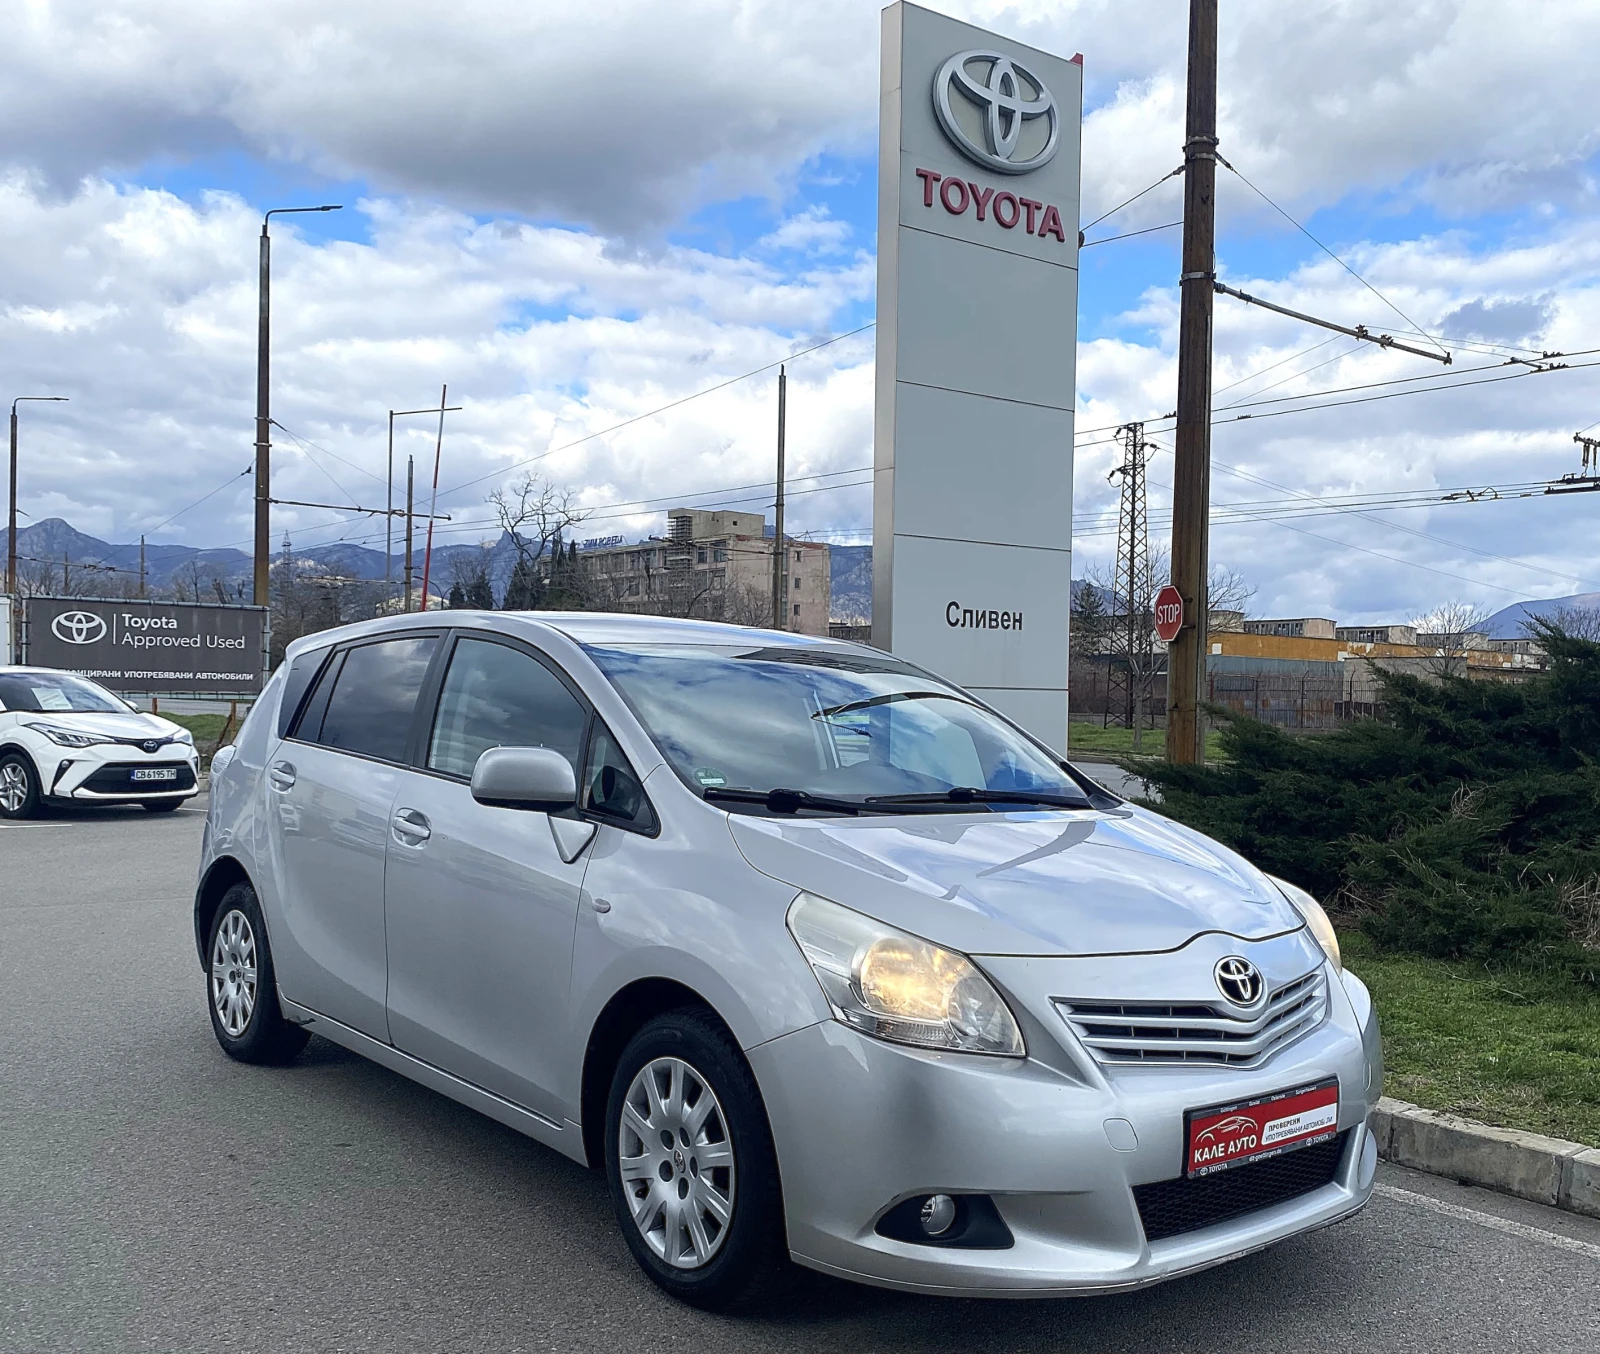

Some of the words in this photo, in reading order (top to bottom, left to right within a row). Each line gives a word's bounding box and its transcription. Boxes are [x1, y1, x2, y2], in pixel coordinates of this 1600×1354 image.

[916, 167, 1066, 243] TOYOTA
[121, 613, 178, 631] Toyota
[945, 600, 1023, 631] Сливен
[1157, 603, 1181, 625] STOP
[121, 632, 201, 650] Approved
[206, 635, 245, 649] Used
[124, 670, 193, 680] УПОТРЕБЯВАНИ
[195, 672, 254, 681] АВТОМОБИЛИ
[147, 771, 165, 779] 6195
[1268, 1117, 1301, 1132] ПРОВЕРЕНИ
[1265, 1125, 1303, 1142] УПОТРЕБЯВАНИ
[1313, 1134, 1329, 1145] TOYOTA
[1194, 1142, 1226, 1164] КАЛЕ
[1227, 1134, 1257, 1155] АУТО
[1209, 1163, 1228, 1173] TOYOTA
